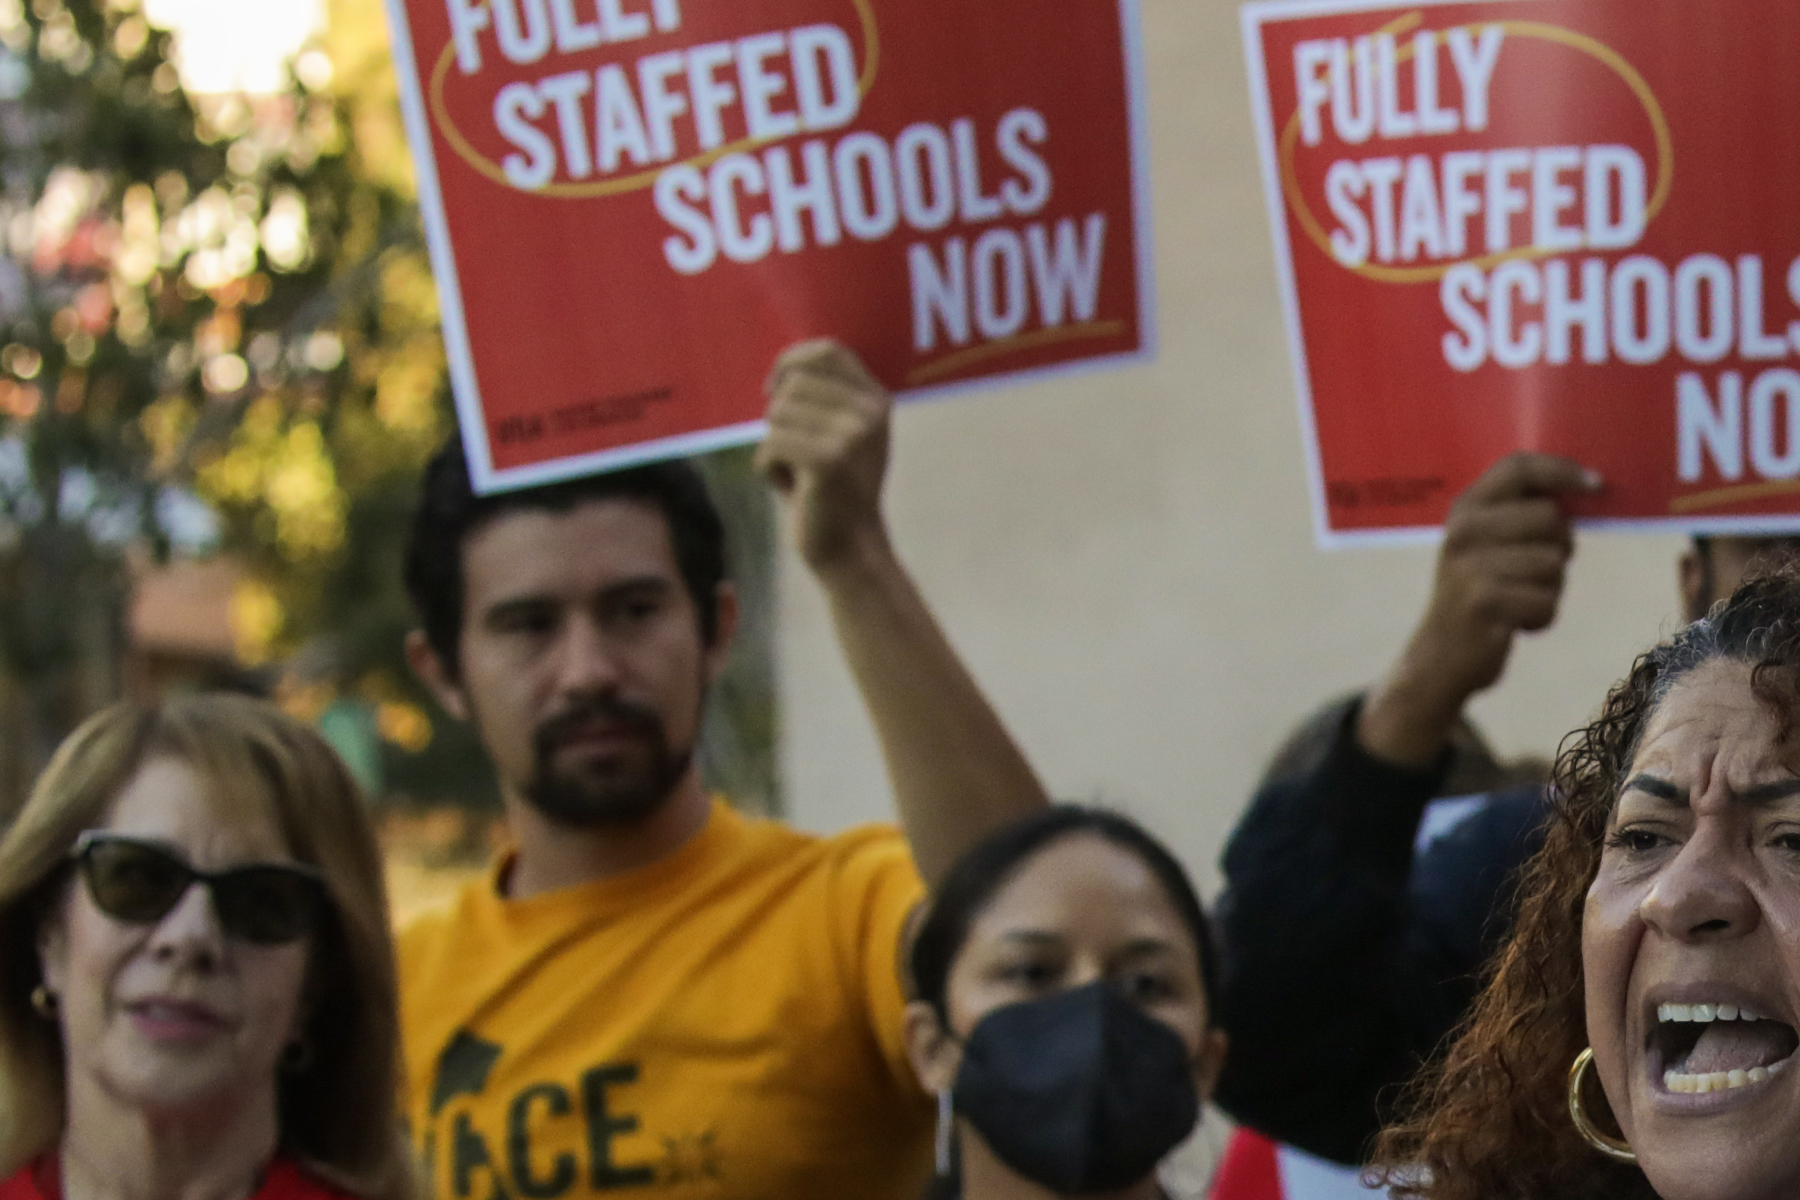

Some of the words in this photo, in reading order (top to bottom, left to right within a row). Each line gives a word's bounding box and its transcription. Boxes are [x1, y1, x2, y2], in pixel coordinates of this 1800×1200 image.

[494, 24, 860, 190] STAFFED
[1294, 26, 1504, 145] FULLY
[653, 108, 1052, 274] SCHOOLS
[1325, 144, 1648, 268] STAFFED
[908, 214, 1105, 350] NOW
